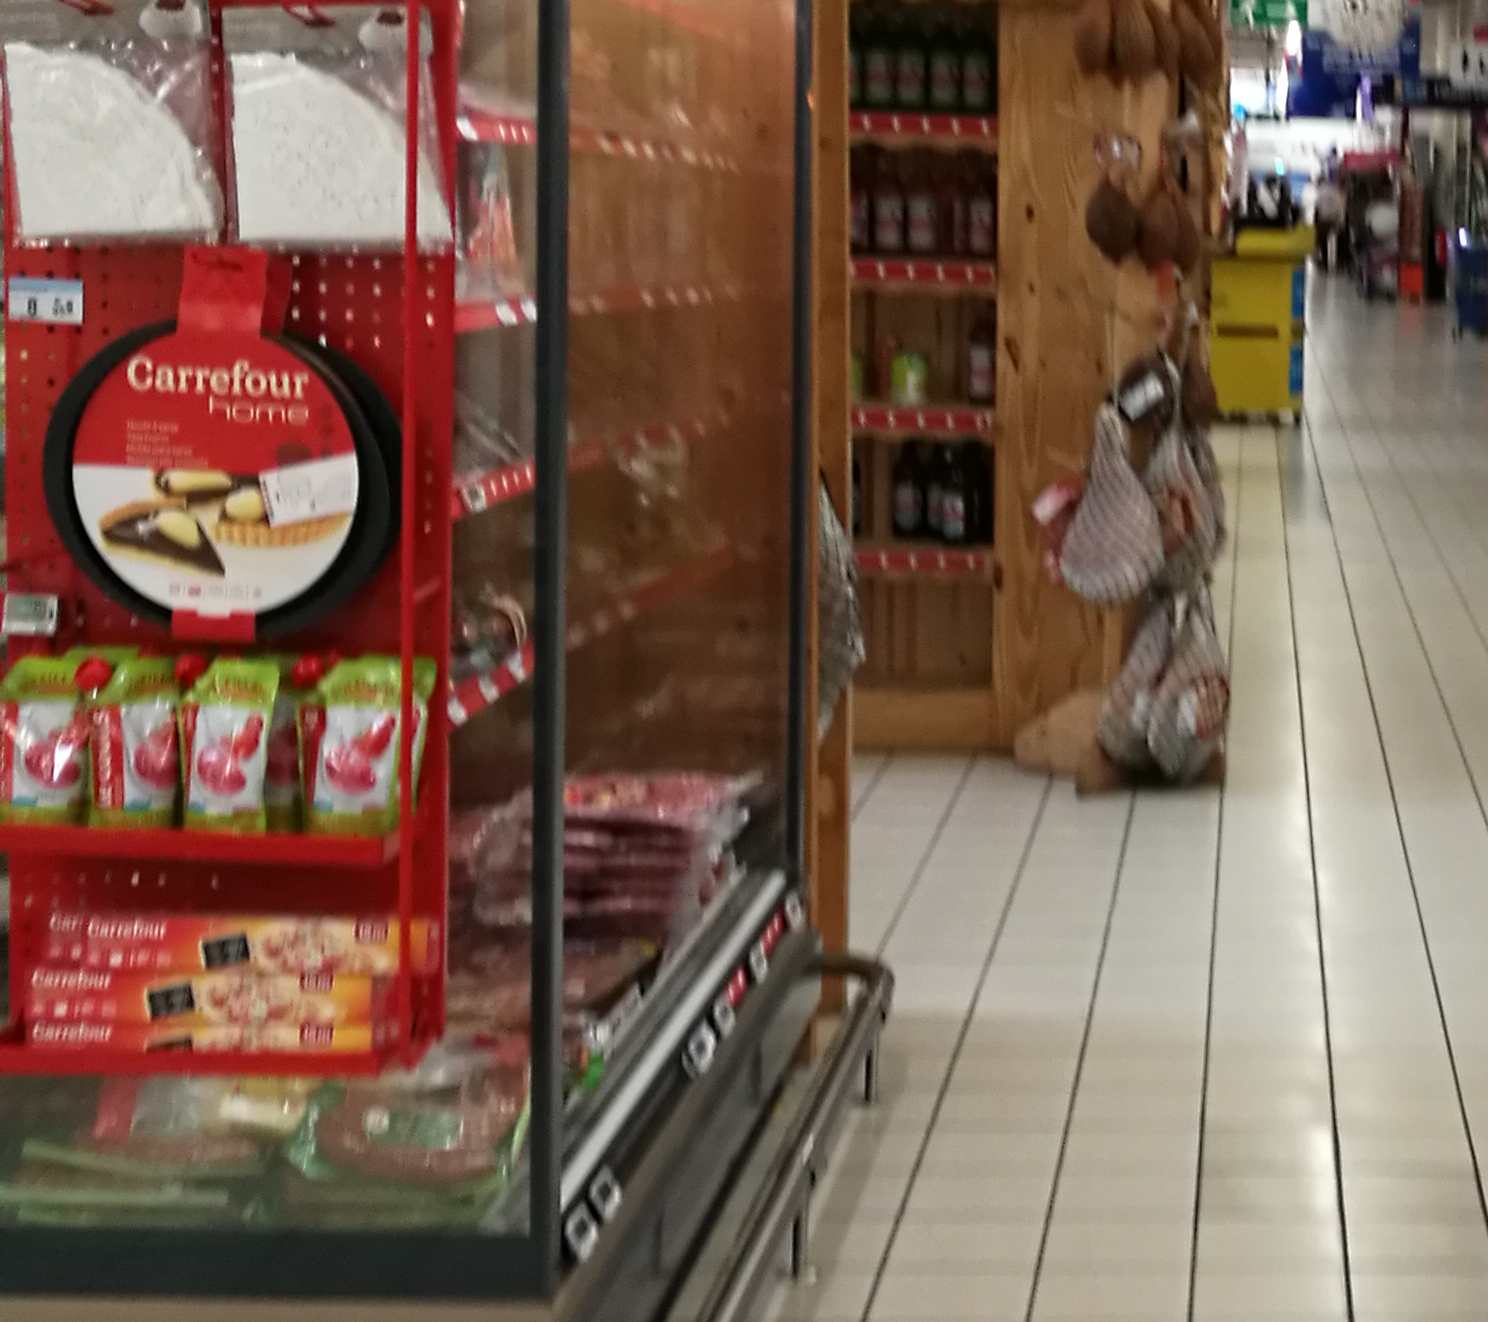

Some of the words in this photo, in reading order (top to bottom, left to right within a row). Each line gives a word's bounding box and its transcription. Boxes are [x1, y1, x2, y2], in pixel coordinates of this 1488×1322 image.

[127, 355, 309, 400] Carrefour
[208, 395, 309, 425] home
[32, 969, 111, 990] Carrefour
[32, 1022, 112, 1041] Carrefour
